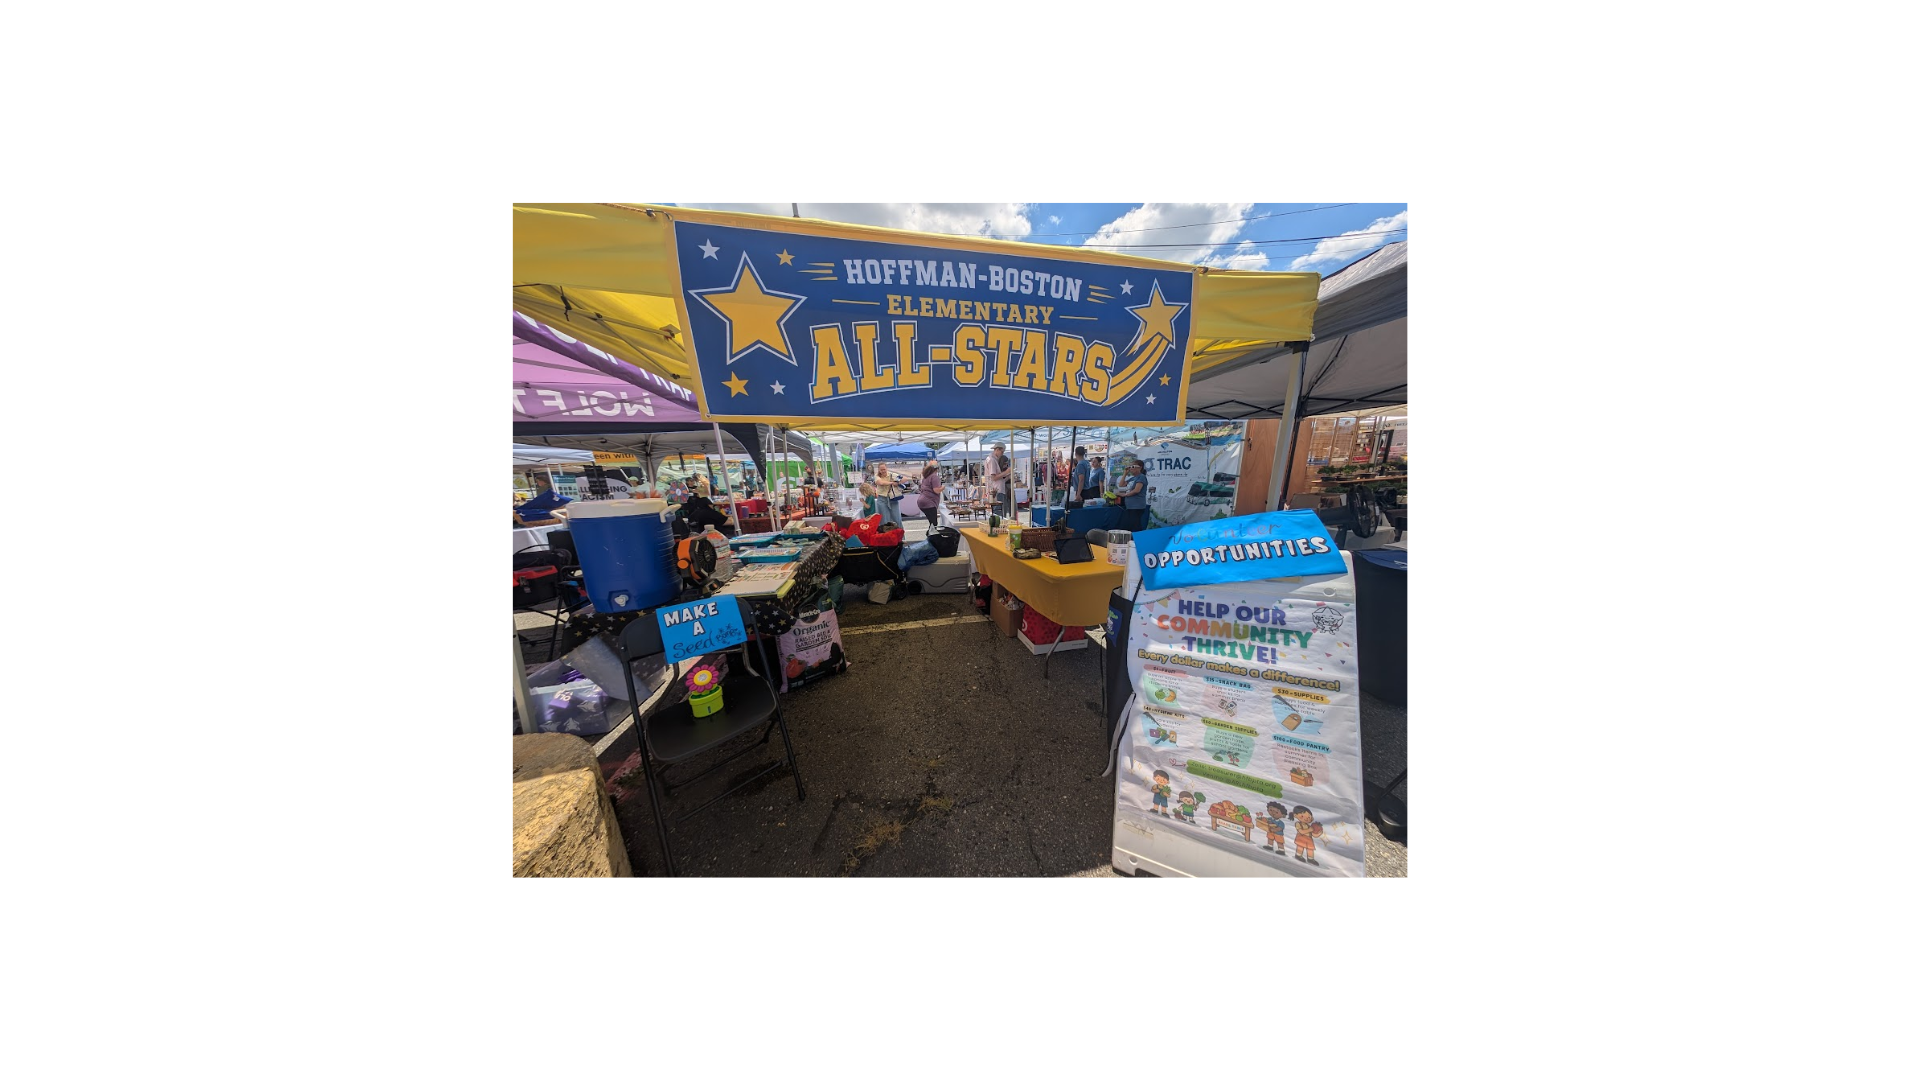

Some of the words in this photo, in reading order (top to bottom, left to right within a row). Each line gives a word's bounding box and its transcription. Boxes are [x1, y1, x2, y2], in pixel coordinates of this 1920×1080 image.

[843, 259, 1083, 302] HOFFMAN-BOSTON
[887, 294, 1054, 324] ELEMENTARY
[809, 320, 1116, 406] ALL-STARS
[1157, 456, 1191, 470] TRAC
[1143, 536, 1331, 569] OPPORTUNITIES
[663, 602, 719, 627] MAKE
[1178, 599, 1230, 619] HELP
[1235, 606, 1287, 626] OUR
[693, 621, 706, 637] A
[793, 620, 830, 636] Organic
[1157, 614, 1314, 649] COMMUNITY
[673, 629, 716, 659] Seed
[1182, 636, 1277, 664] THRIVE!
[1138, 648, 1169, 664] Every
[1170, 654, 1205, 669] dollar
[1206, 660, 1248, 678] makes
[1249, 668, 1260, 678] a
[1261, 671, 1341, 692] difference!
